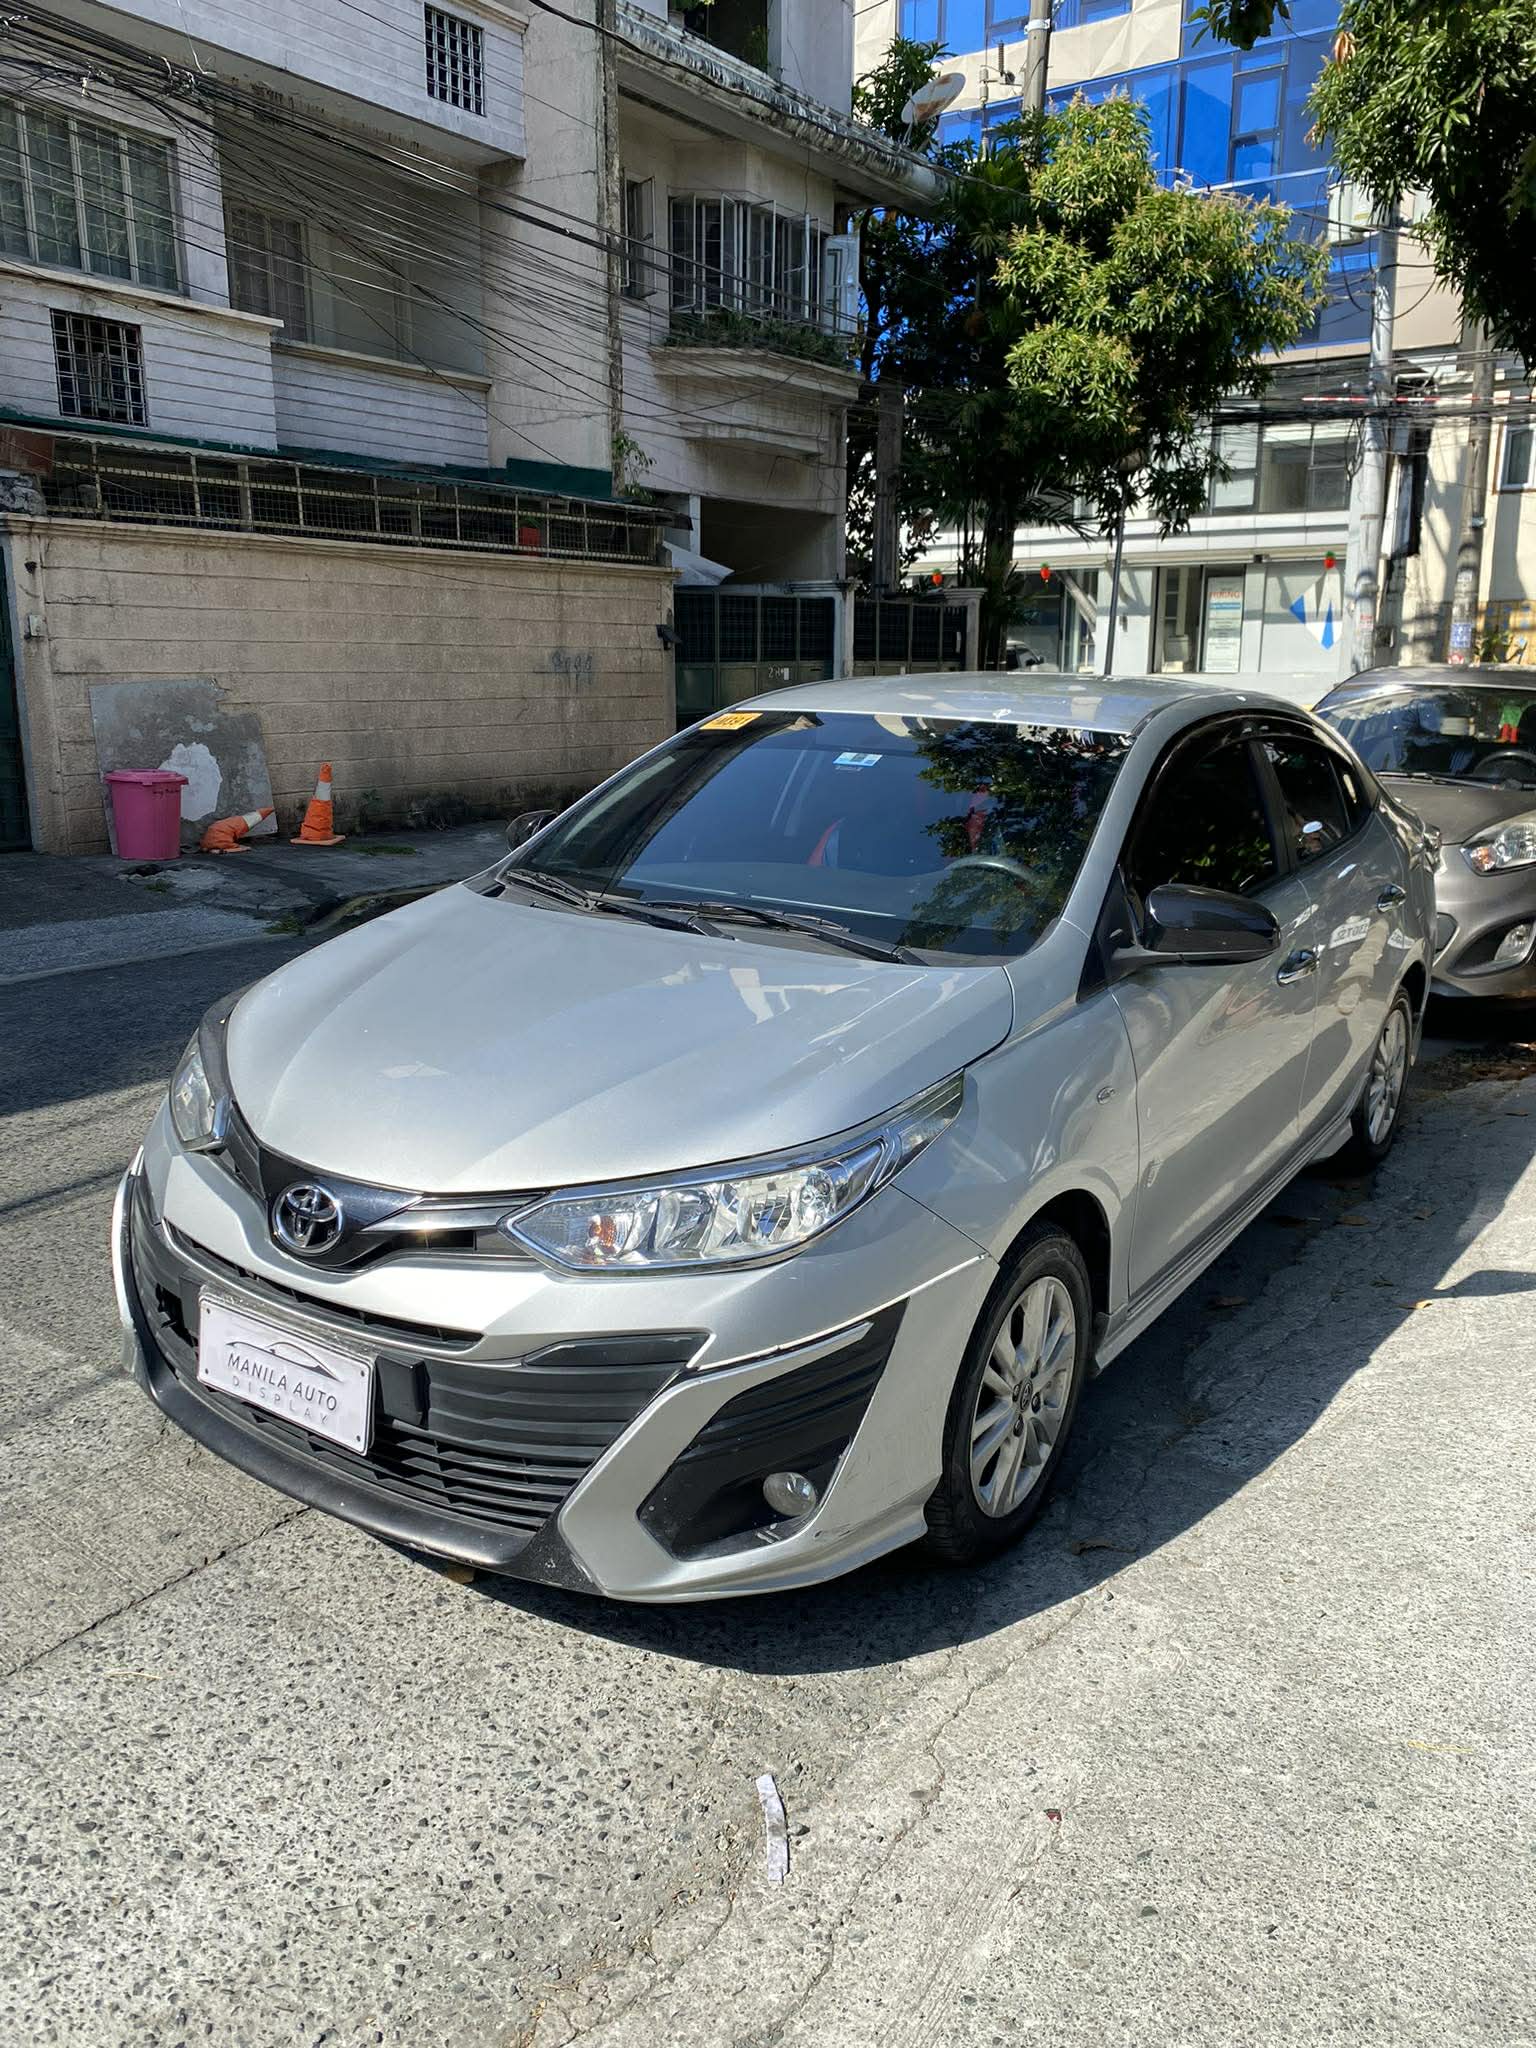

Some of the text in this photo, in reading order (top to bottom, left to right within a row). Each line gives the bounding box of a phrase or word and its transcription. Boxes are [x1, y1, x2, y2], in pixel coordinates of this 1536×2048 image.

[227, 1353, 338, 1411] MANILA AUTO
[232, 1375, 328, 1425] DISPLAY
